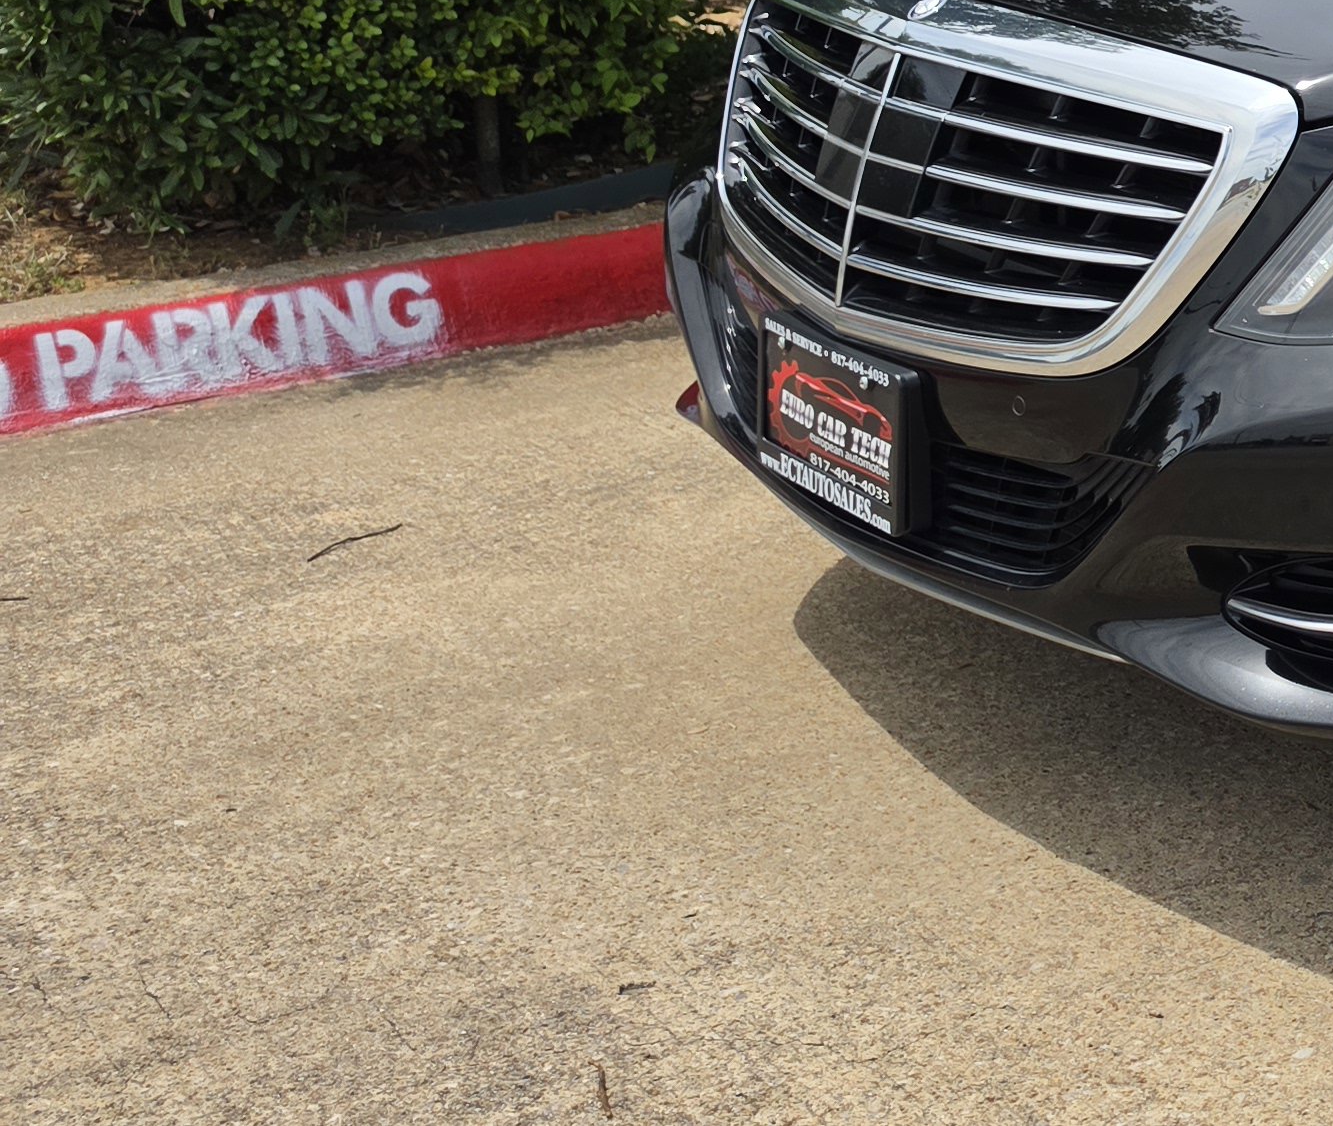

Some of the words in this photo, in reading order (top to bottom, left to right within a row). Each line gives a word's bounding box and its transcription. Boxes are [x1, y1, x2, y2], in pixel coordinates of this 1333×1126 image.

[34, 272, 443, 411] PARKING
[765, 317, 786, 337] SALES
[792, 331, 823, 357] SERVICE
[831, 351, 890, 387] 817-404-4033
[780, 388, 815, 429] EURO
[817, 412, 847, 448] CAR
[850, 427, 892, 469] TECH
[809, 432, 844, 458] european
[844, 451, 890, 481] automotive
[760, 451, 892, 535] www.ECTAUTOSALES.com
[810, 452, 890, 504] 817-404-4033
